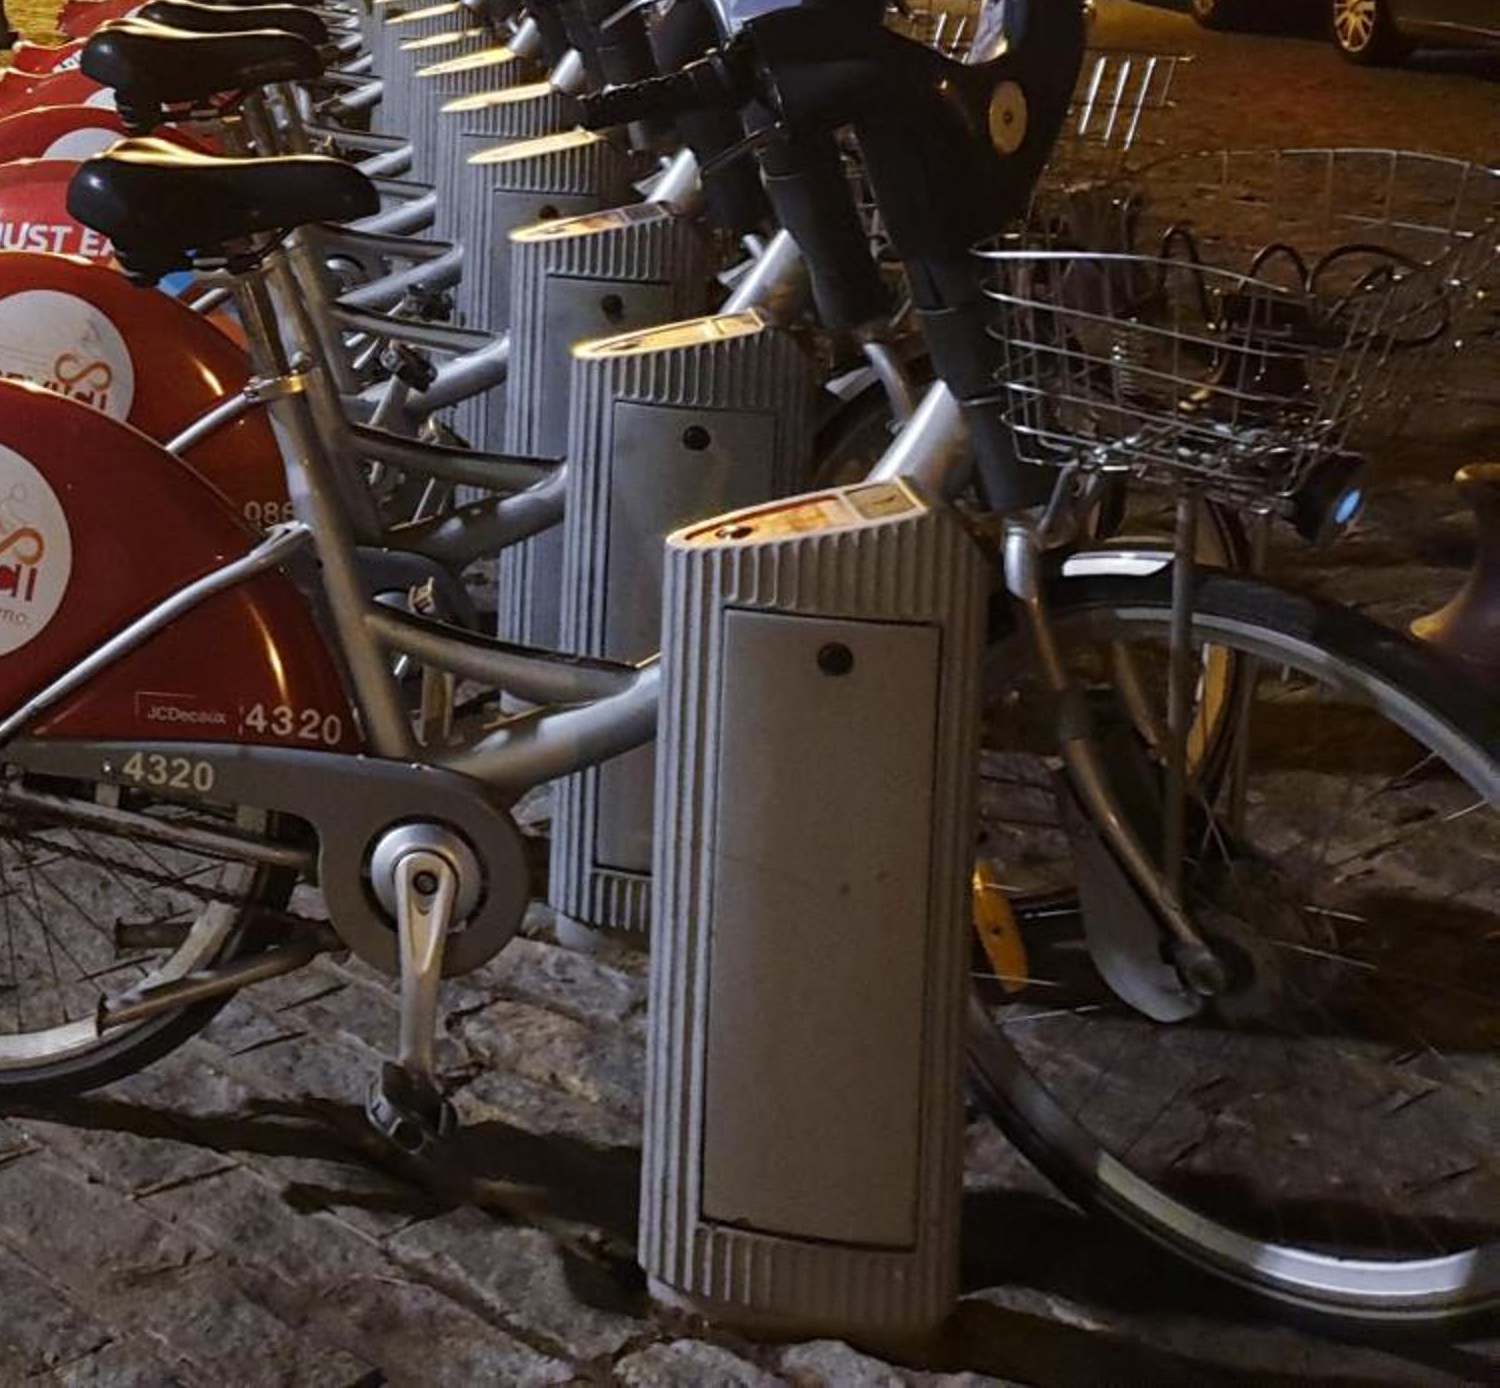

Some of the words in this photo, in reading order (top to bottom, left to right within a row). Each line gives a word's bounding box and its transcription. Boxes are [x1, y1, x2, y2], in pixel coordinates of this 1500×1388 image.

[147, 706, 227, 725] JCDecaux
[244, 702, 343, 746] 4320
[122, 751, 215, 792] 4320
